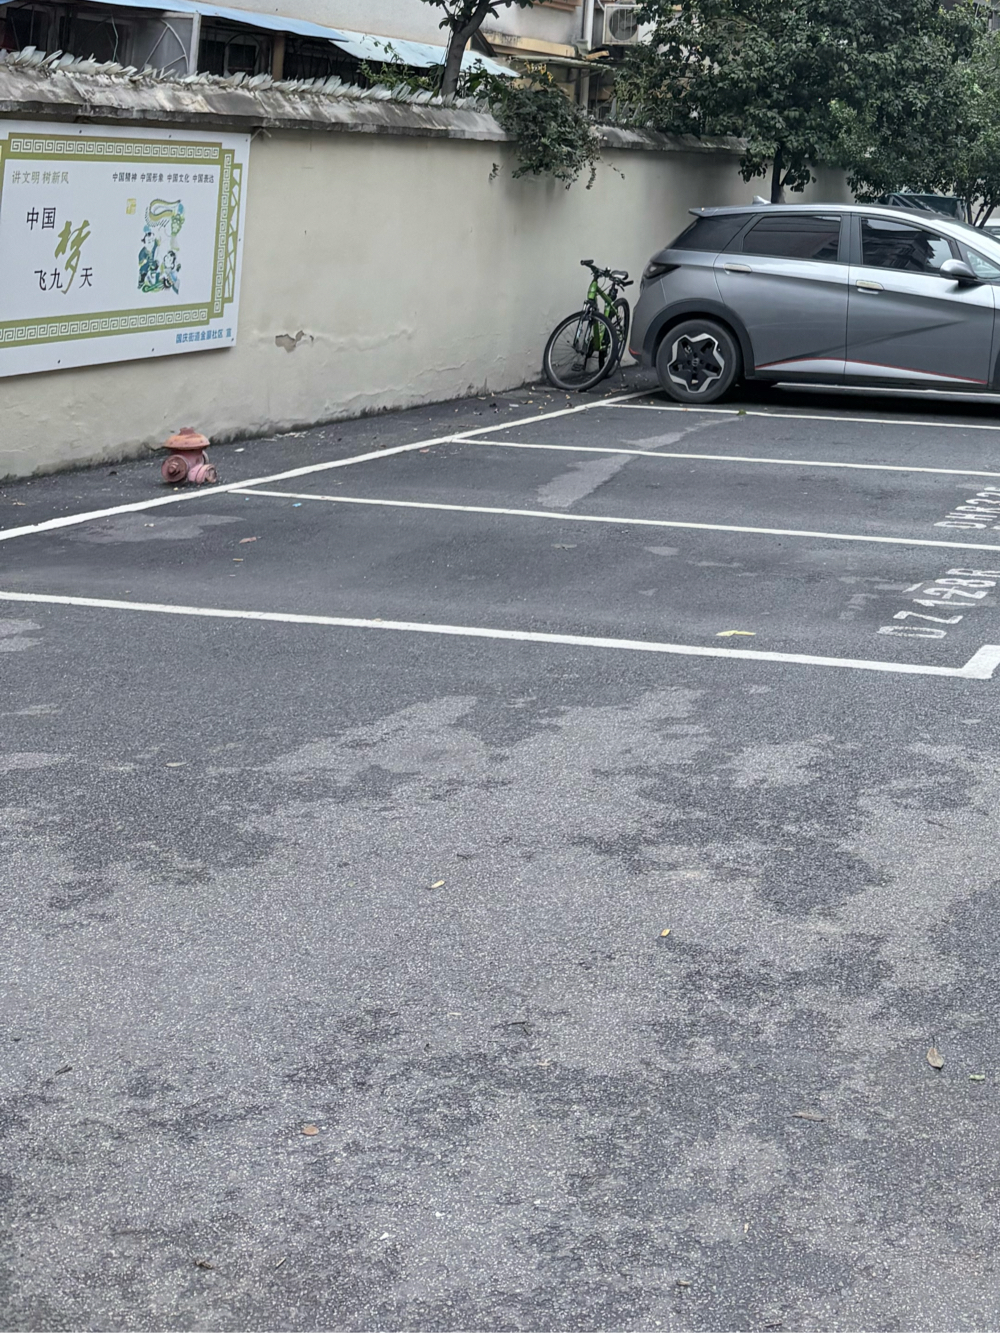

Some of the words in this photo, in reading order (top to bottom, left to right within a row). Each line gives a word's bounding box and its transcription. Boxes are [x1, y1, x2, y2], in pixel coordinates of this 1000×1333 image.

[11, 170, 40, 184] 讲文明
[42, 170, 69, 184] 树新风
[112, 172, 138, 183] 中国精神
[166, 173, 190, 184] 中国文化
[34, 267, 93, 291] 飞九天
